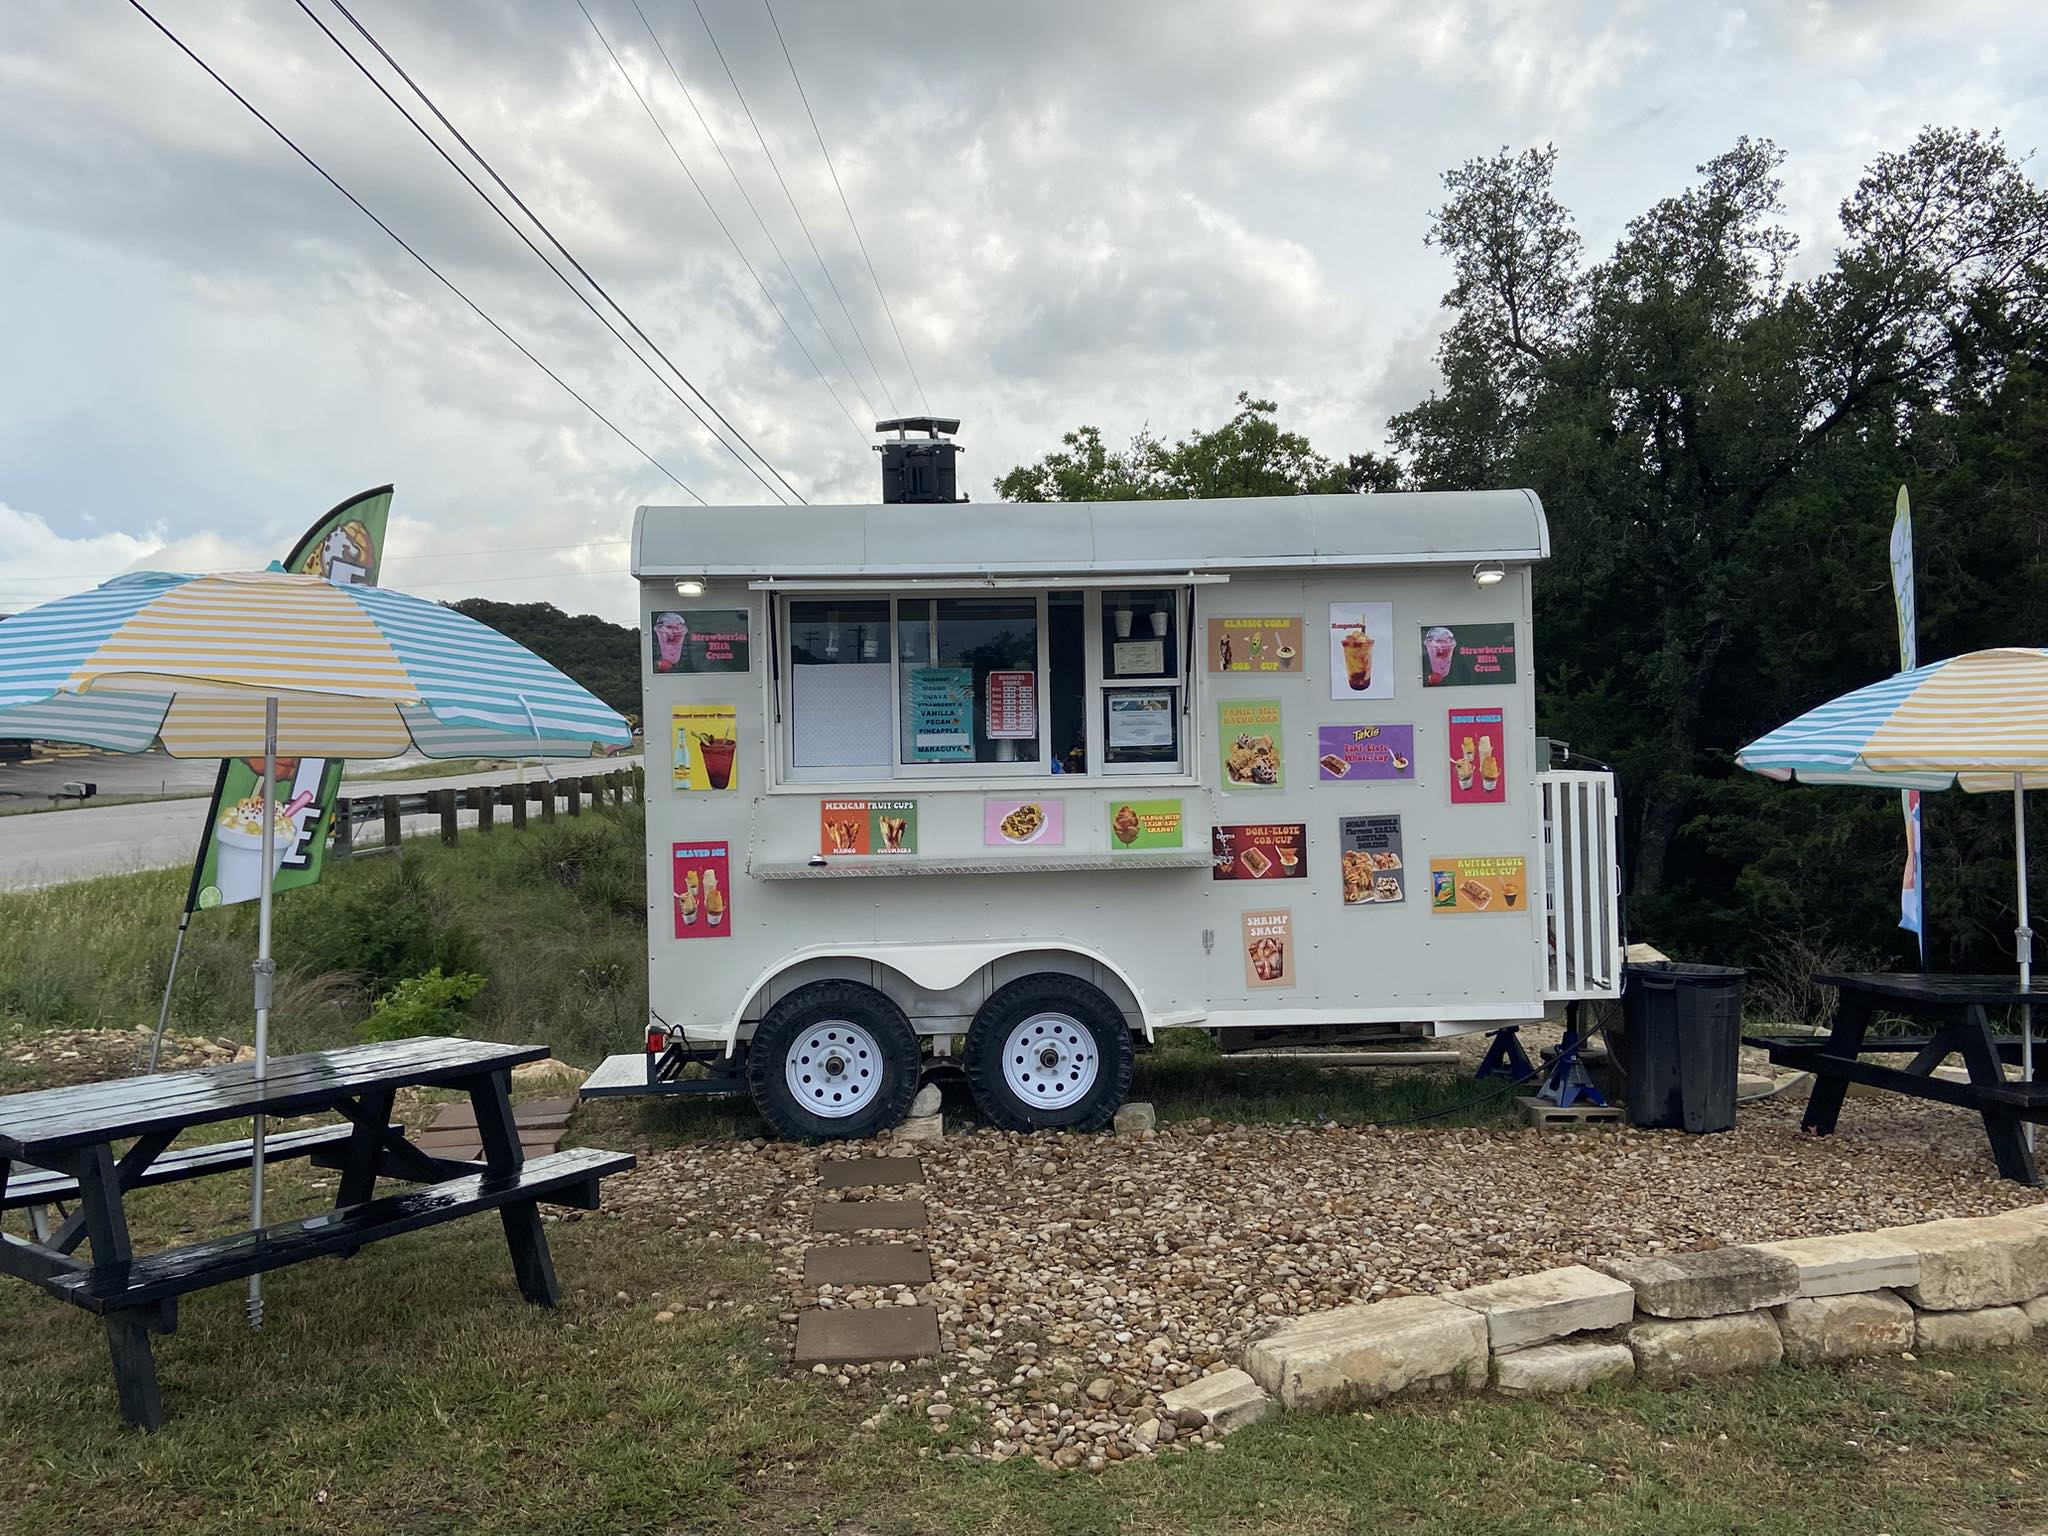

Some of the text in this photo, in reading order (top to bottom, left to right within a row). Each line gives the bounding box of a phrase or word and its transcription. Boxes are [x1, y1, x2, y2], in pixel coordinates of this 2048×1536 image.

[1460, 645, 1514, 654] Strawberries
[1477, 655, 1498, 663] With
[1261, 662, 1279, 670] CUP
[1353, 728, 1380, 741] Takis
[825, 802, 865, 810] MEXICAN
[1246, 826, 1300, 836] DORI-ELOTE
[1254, 836, 1293, 845] COB/CUP
[1458, 857, 1523, 867] RUFFLE-ELOTE
[1464, 867, 1518, 877] WHOLE/CUP
[1247, 915, 1288, 926] SHRIMP
[1250, 926, 1286, 936] SNACK
